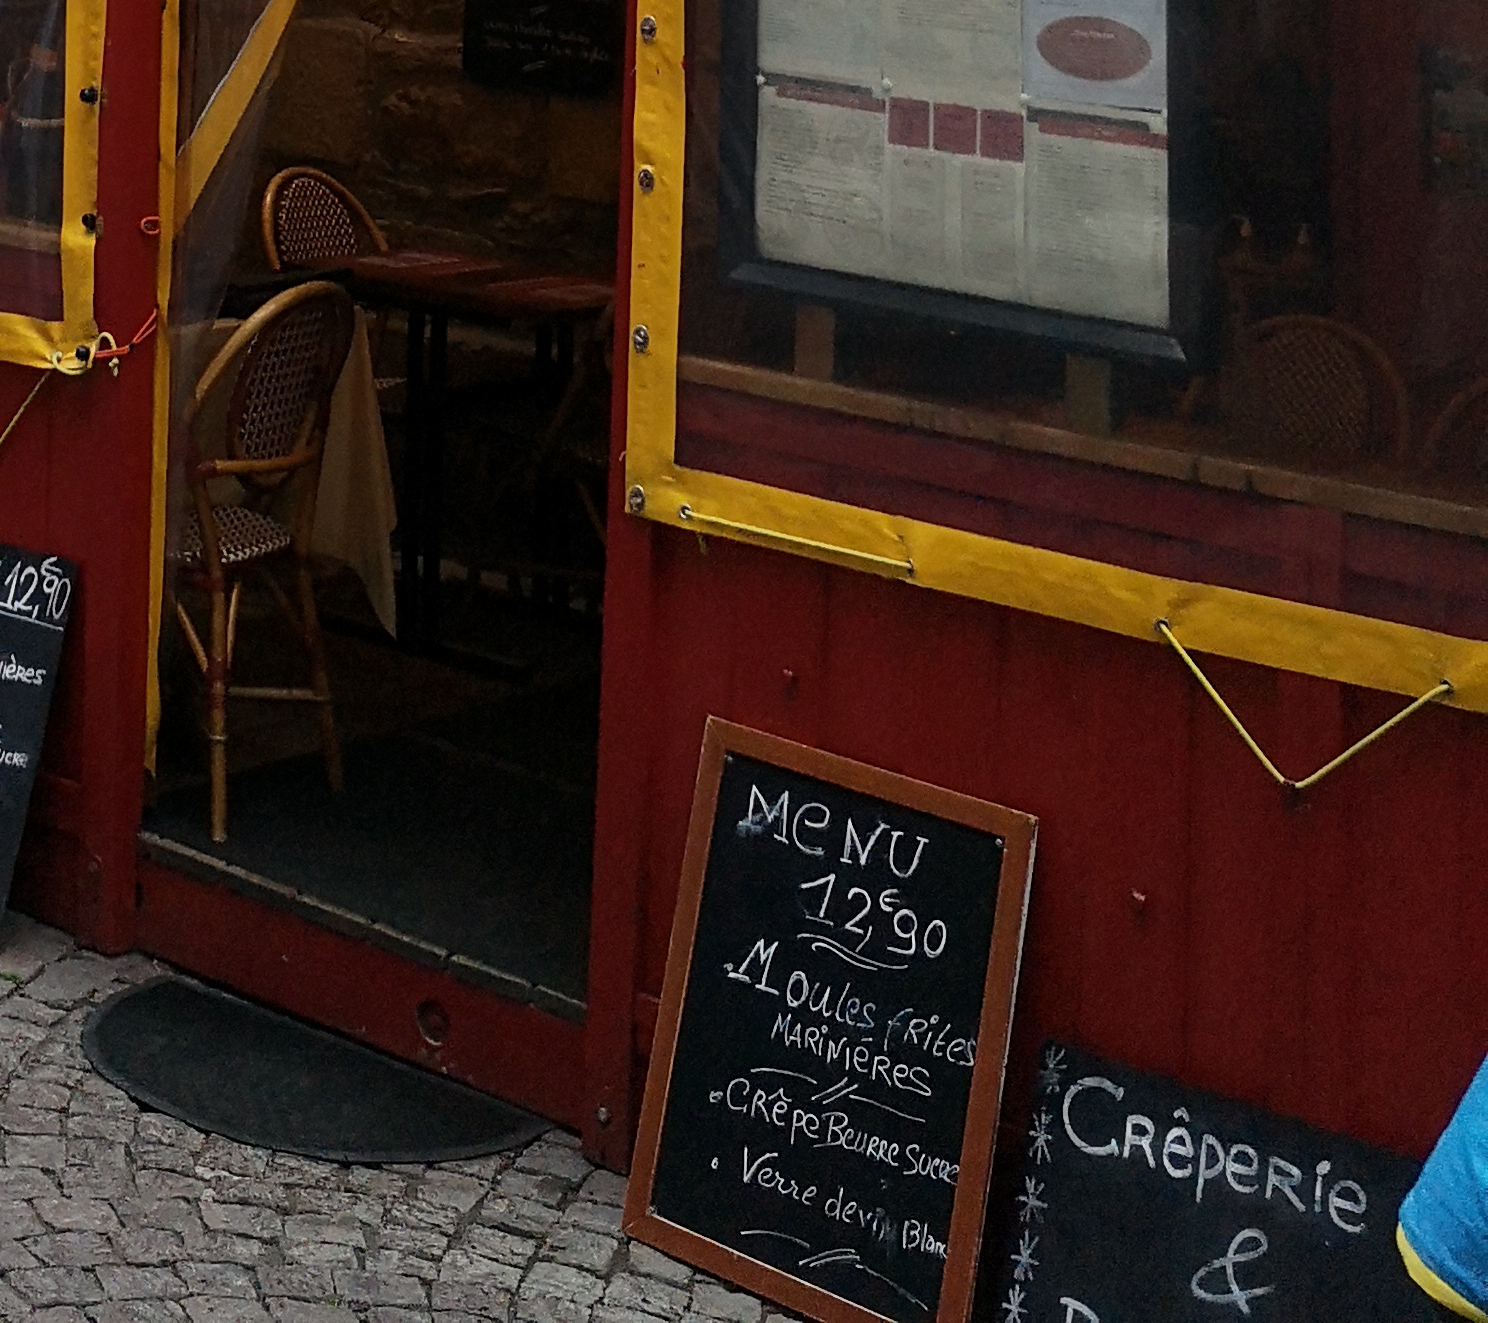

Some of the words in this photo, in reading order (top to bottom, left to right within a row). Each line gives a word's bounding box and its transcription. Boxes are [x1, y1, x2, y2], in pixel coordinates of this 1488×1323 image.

[727, 939, 875, 1028] Moules
[742, 1145, 817, 1205] Verre
[1191, 1227, 1275, 1315] &
